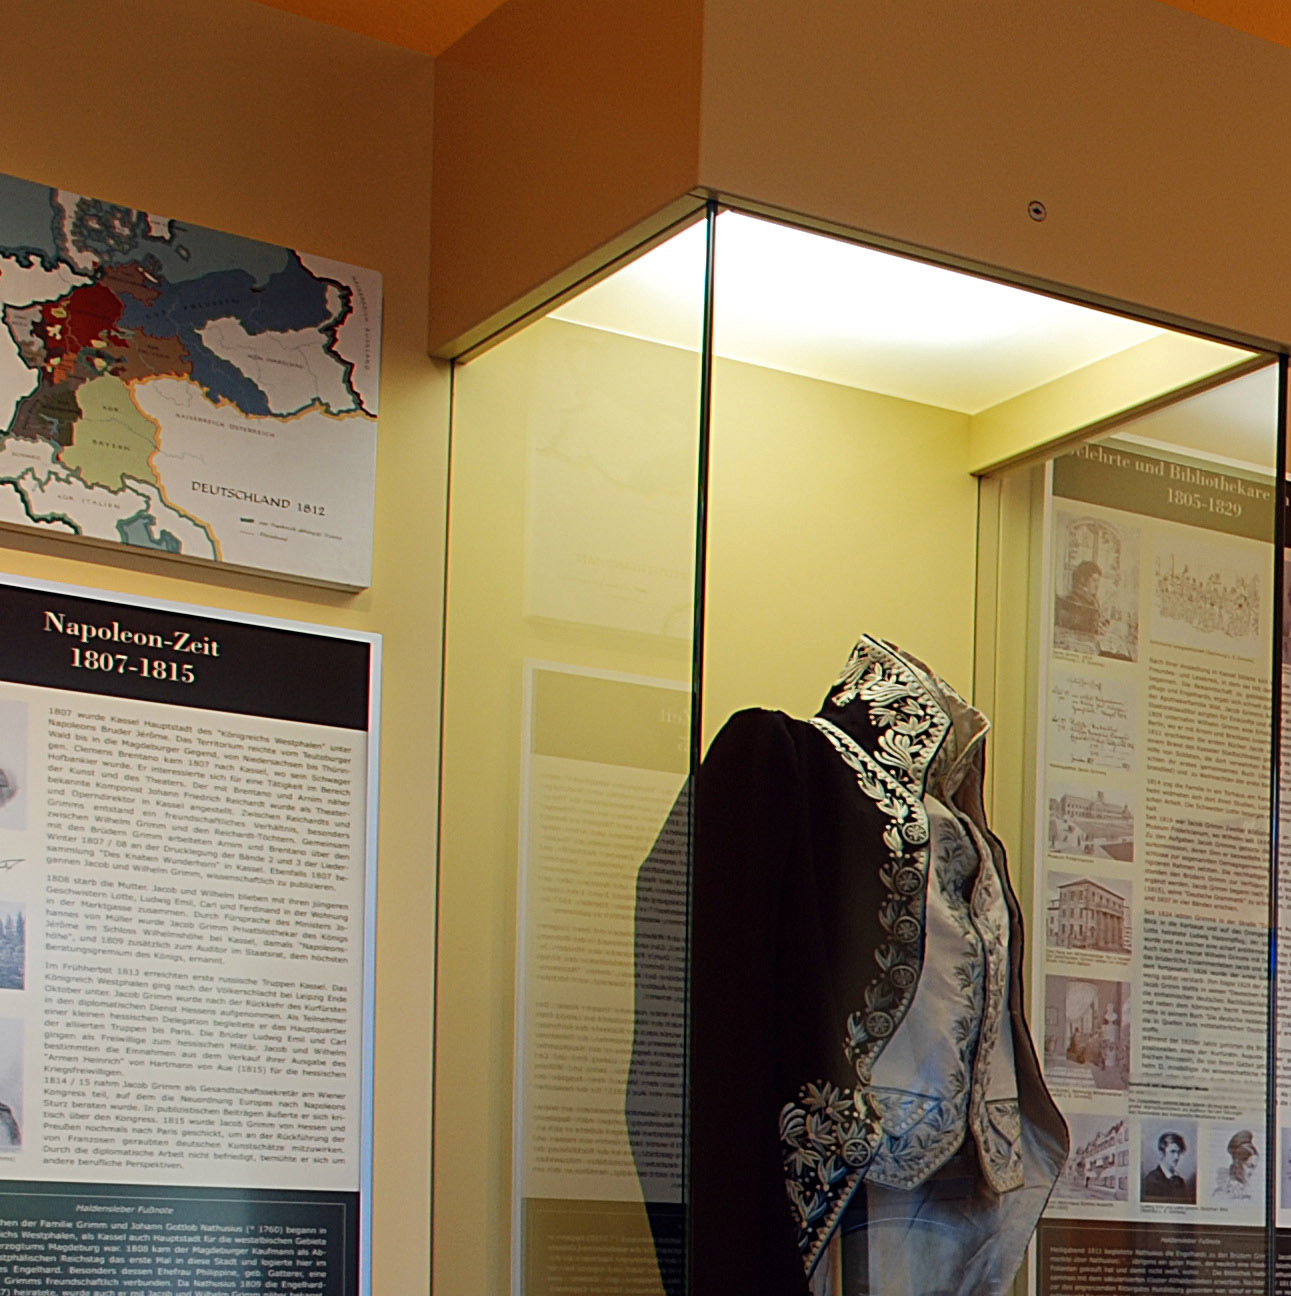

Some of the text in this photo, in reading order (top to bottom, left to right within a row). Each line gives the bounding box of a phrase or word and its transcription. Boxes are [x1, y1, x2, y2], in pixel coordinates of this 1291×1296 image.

[1135, 460, 1164, 476] und
[1170, 463, 1271, 500] Bibliothekare
[192, 481, 325, 516] DEUTSCHLAND 1812
[1167, 487, 1242, 518] 1805-1829
[44, 611, 220, 657] Napoleon-Zeit
[70, 648, 195, 684] 1807-1815
[0, 1219, 18, 1227] hen
